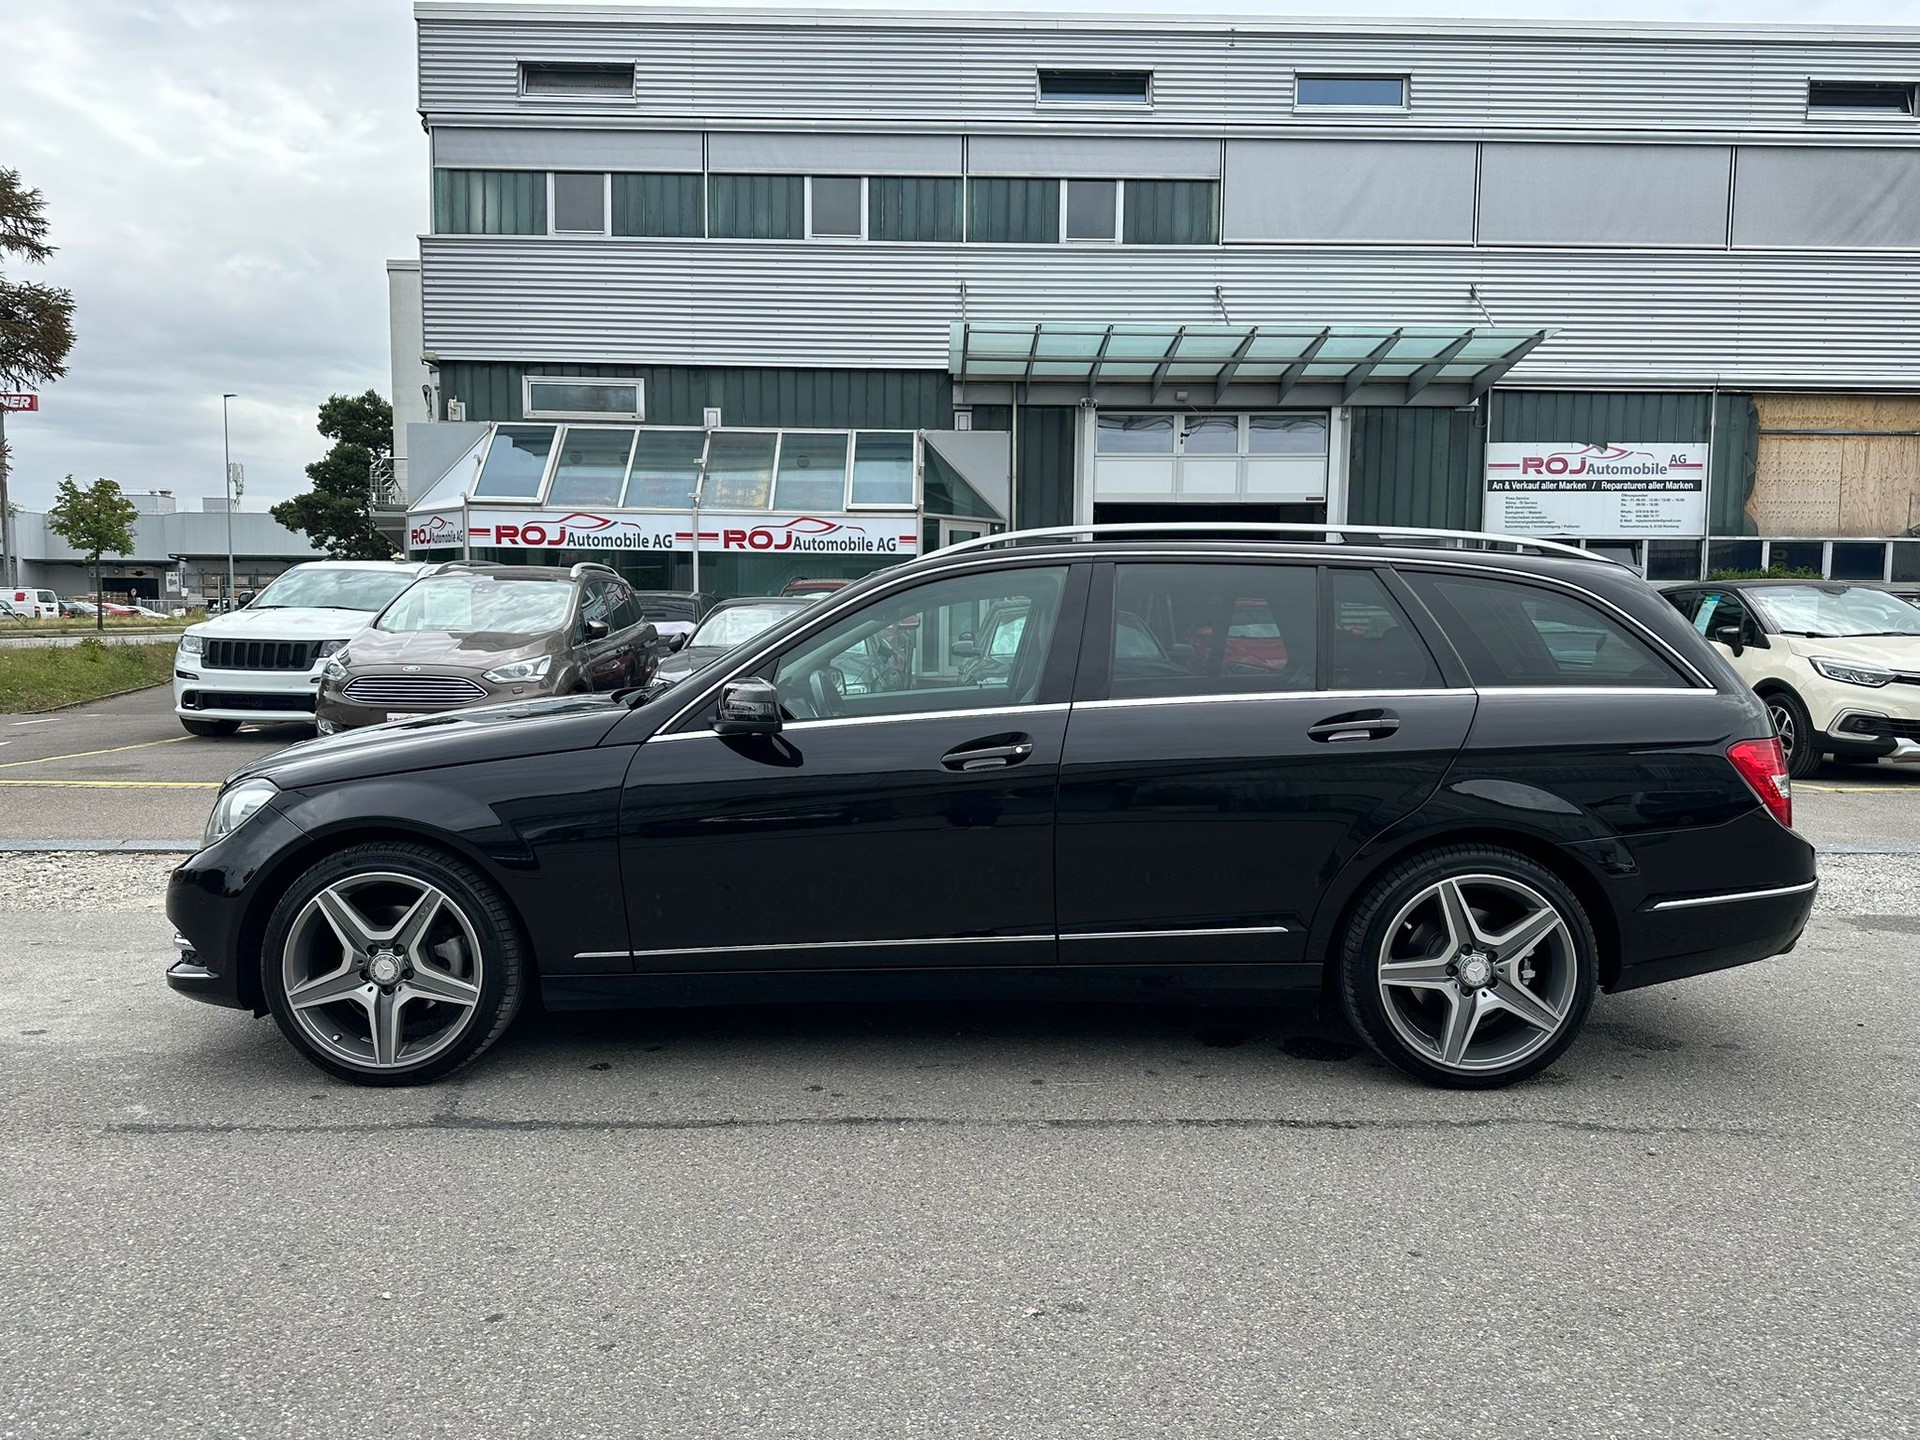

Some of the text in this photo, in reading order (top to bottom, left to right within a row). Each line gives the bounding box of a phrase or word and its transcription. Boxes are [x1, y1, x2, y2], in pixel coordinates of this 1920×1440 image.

[1522, 454, 1687, 475] ROJ Automobile AG
[1492, 481, 1503, 490] An
[1504, 481, 1511, 490] &
[1512, 481, 1540, 490] Verkauf
[1541, 481, 1558, 490] aller
[1559, 481, 1587, 490] Marken
[1601, 481, 1647, 491] Reparaturen
[1648, 481, 1665, 490] aller
[1666, 481, 1694, 490] Marken
[411, 528, 432, 545] ROJ
[495, 525, 673, 548] ROJ Automobile AG
[723, 529, 896, 552] ROJ Automobile AG
